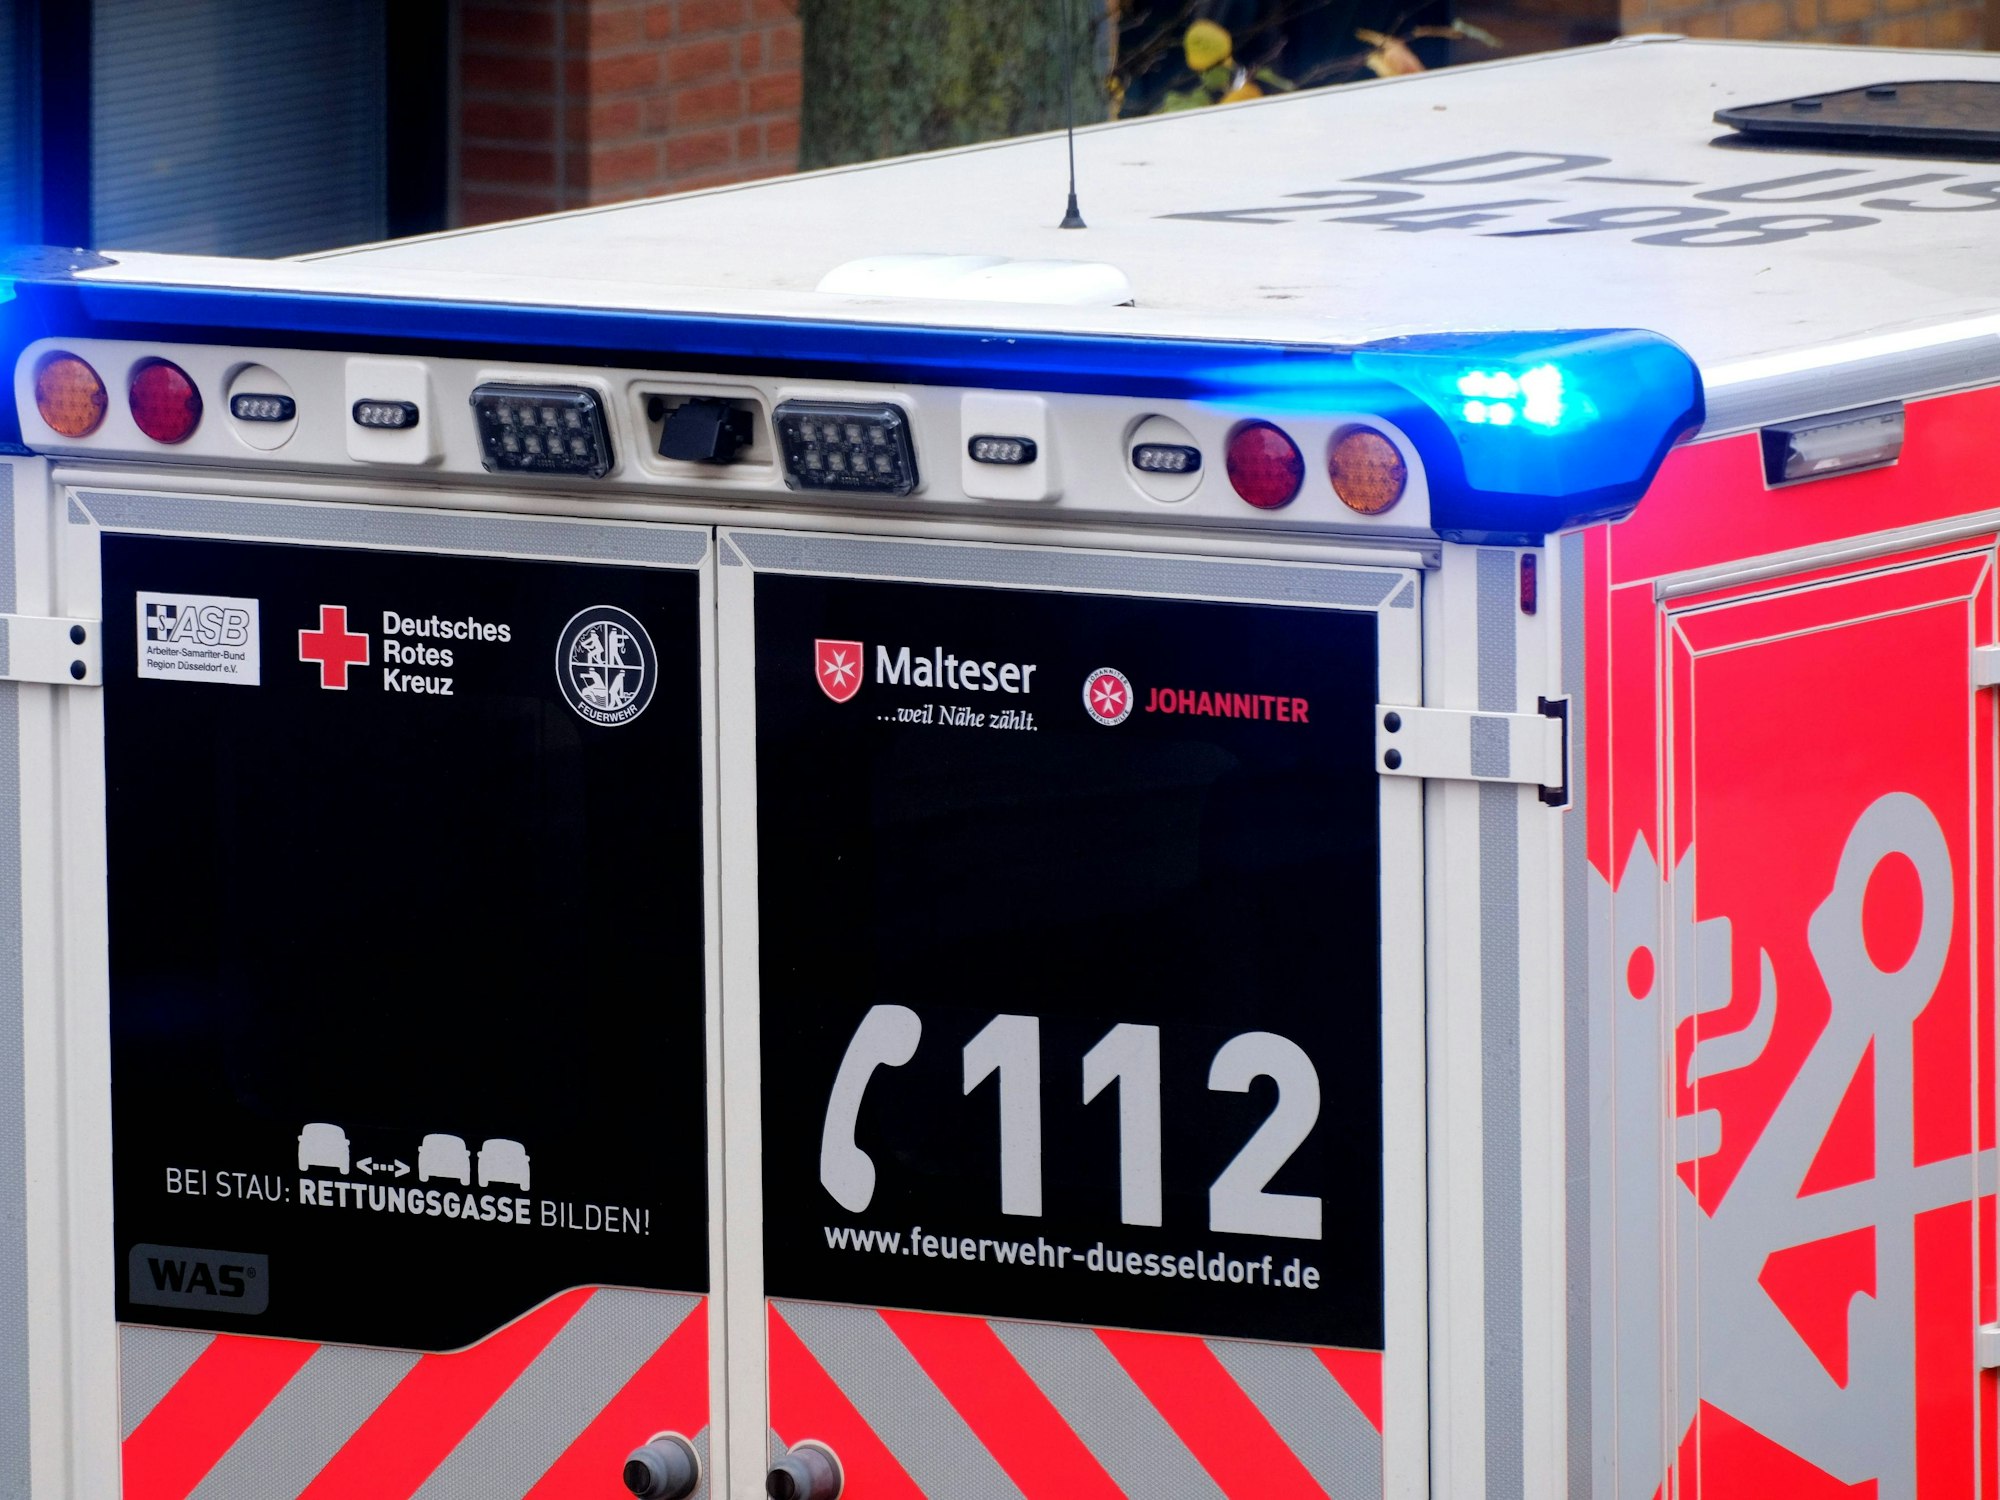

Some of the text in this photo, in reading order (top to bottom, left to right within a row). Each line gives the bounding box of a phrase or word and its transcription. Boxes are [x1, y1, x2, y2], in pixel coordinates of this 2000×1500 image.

[1150, 190, 1882, 247] 2498
[169, 605, 250, 646] ASB
[382, 610, 512, 643] Deutsches
[146, 646, 246, 661] Arbeiter-Samariter-Bund
[146, 658, 238, 674] Region Düsseldorf e.V.
[383, 639, 454, 668] Rotes
[876, 644, 1037, 694] Malteser
[383, 667, 454, 696] Kreuz
[577, 701, 639, 723] FEUERWEHR
[938, 704, 986, 728] Nähe
[988, 708, 1038, 732] zählt.
[1145, 687, 1310, 724] JOHANNITER
[962, 1013, 1323, 1241] 112
[166, 1167, 650, 1235] BEI STAU: RETTUNGSGASSE BILDEN!
[823, 1226, 1320, 1290] www.feuerwehr-duesseldorf.de
